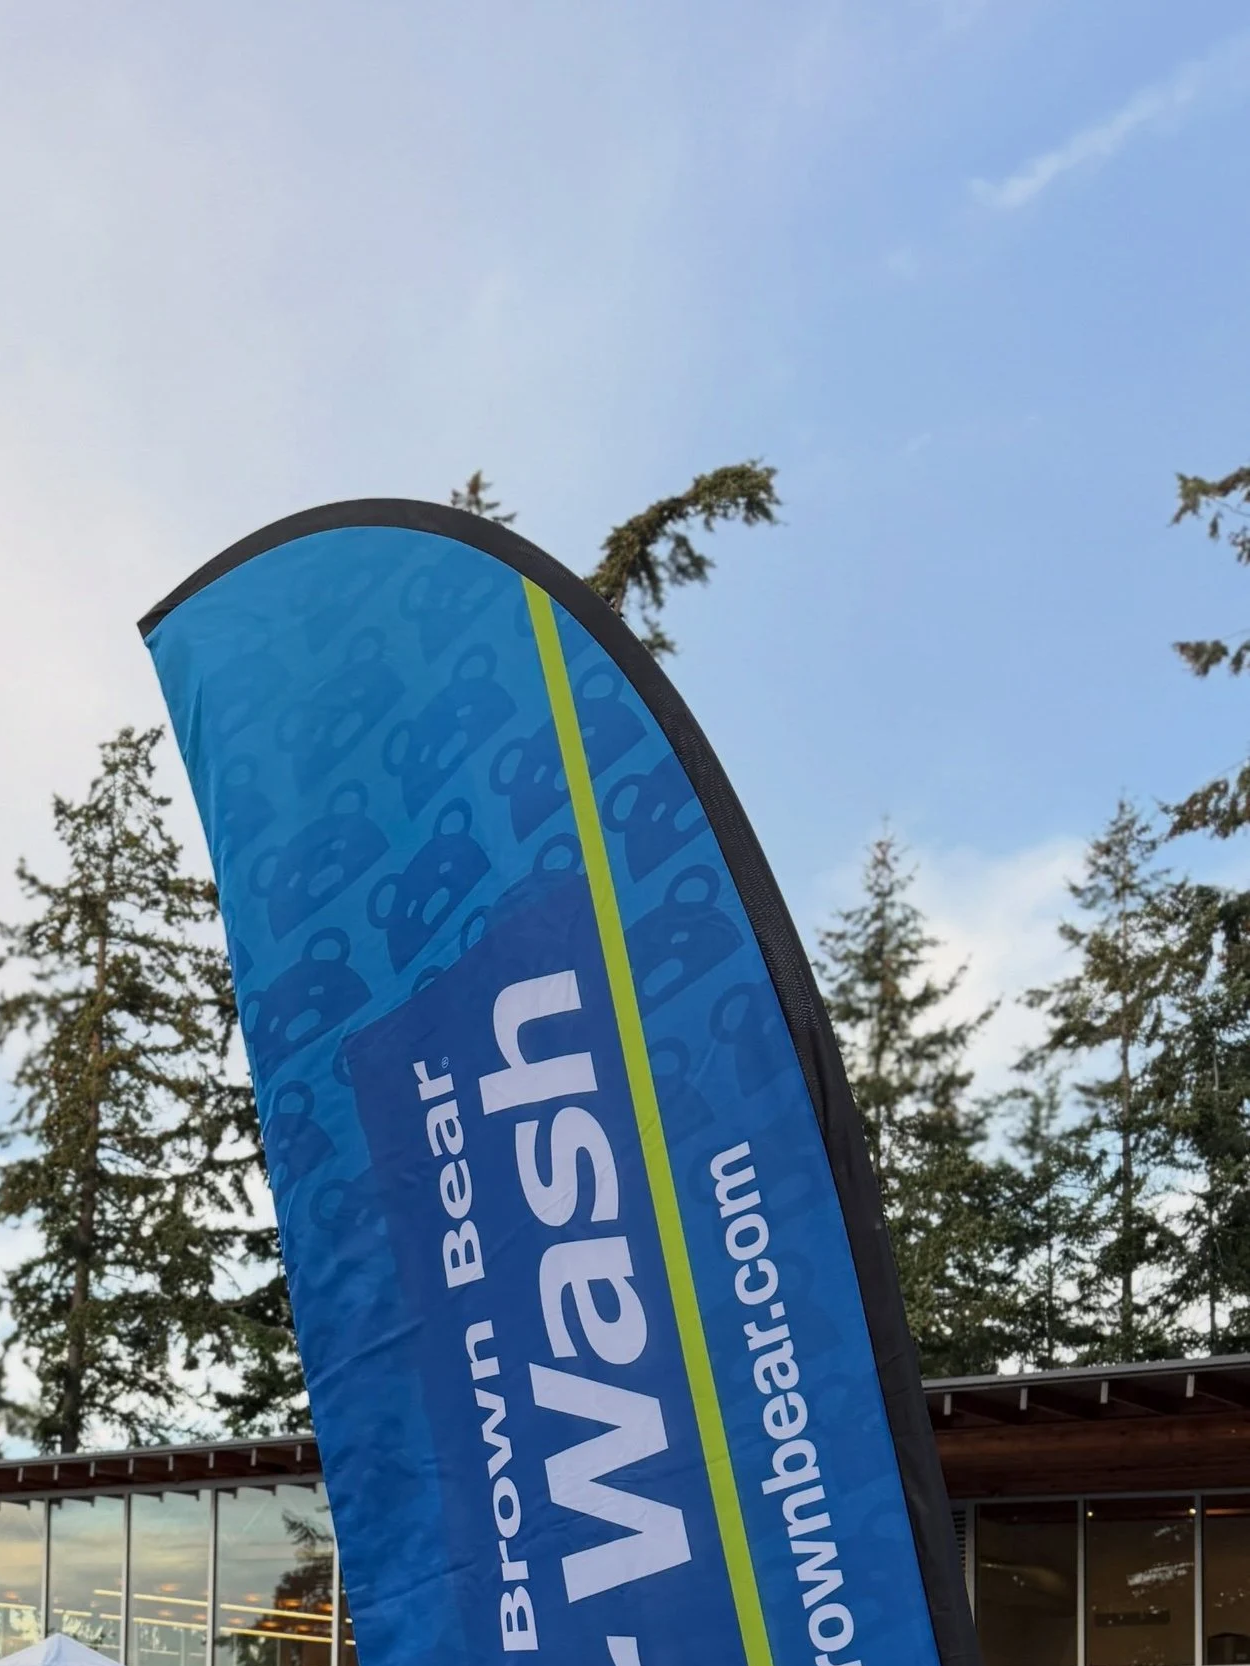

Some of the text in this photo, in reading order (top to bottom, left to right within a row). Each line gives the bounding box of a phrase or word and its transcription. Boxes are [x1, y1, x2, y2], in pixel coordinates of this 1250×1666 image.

[413, 1060, 539, 1652] Brown Bear
[478, 969, 692, 1603] Wash
